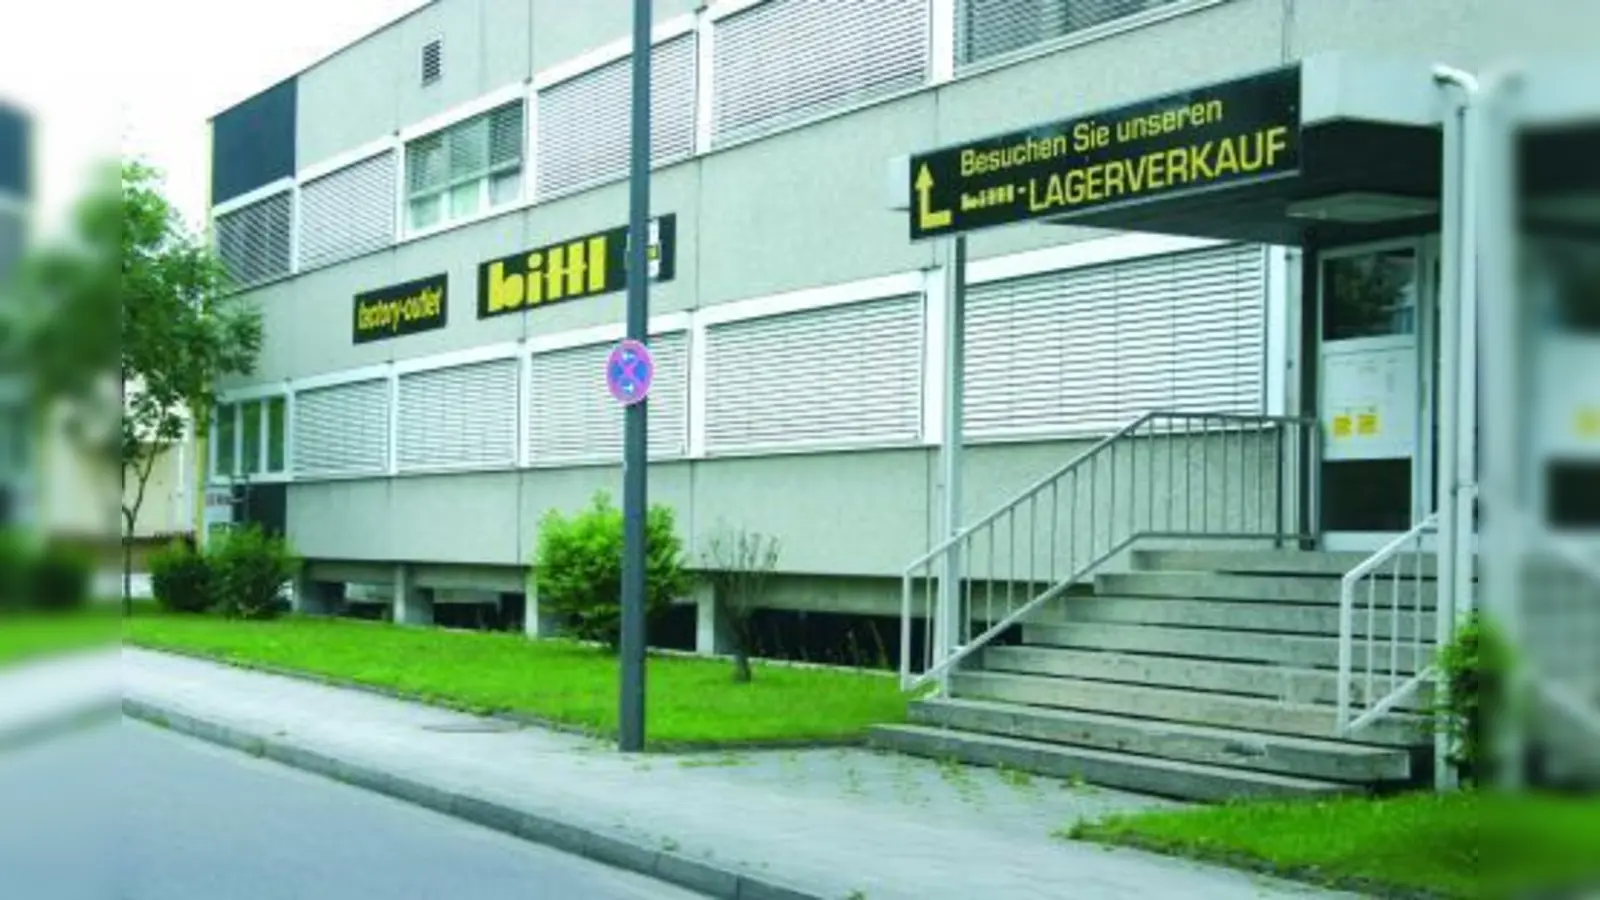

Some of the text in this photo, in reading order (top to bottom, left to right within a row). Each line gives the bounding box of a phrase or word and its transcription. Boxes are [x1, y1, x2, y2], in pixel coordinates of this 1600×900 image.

[960, 98, 1223, 176] Besuchen Sie unseren
[487, 236, 607, 312] bittl
